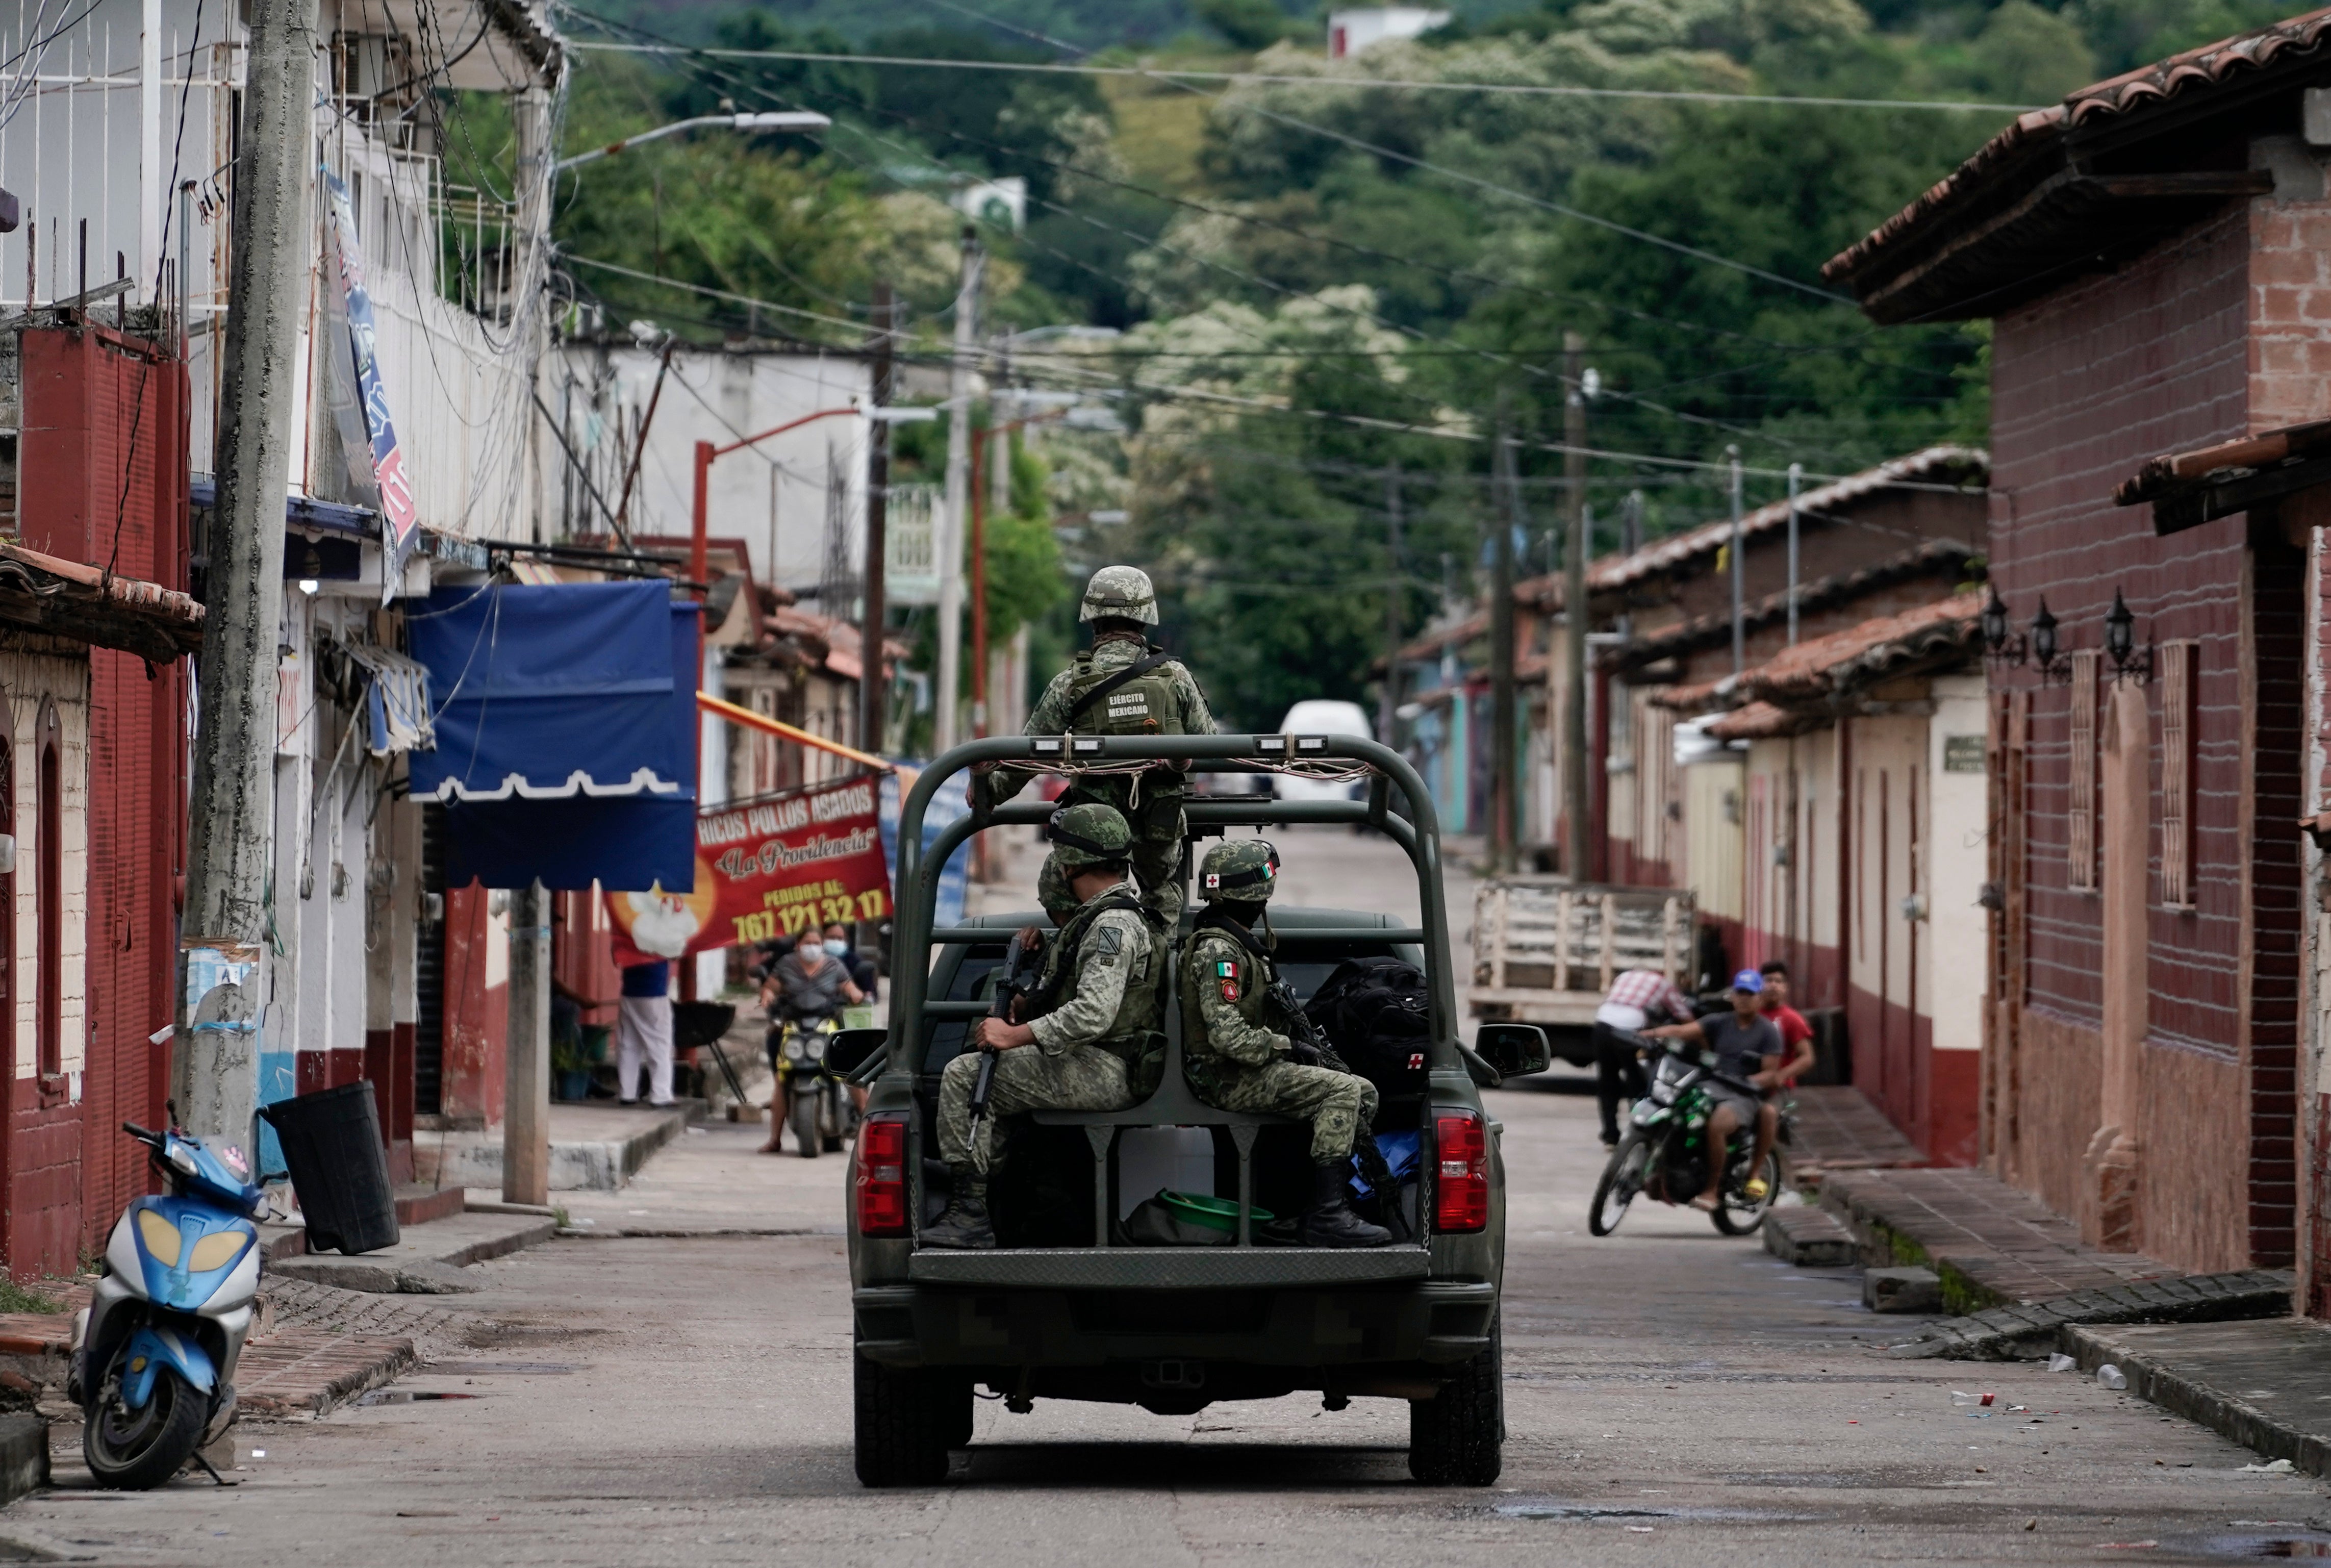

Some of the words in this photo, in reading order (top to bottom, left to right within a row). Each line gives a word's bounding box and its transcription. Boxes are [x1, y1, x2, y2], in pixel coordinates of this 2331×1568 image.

[1108, 704, 1148, 717] MEXICANO
[1109, 693, 1144, 704] EJÉRCITO
[697, 812, 746, 845] RICOS
[748, 799, 808, 835] POLLOS
[812, 785, 873, 822] ASADOS
[763, 882, 822, 907] PEDIDOS
[732, 909, 774, 944] 767
[777, 901, 819, 934] 121
[820, 895, 855, 923] 32
[856, 889, 883, 919] 17
